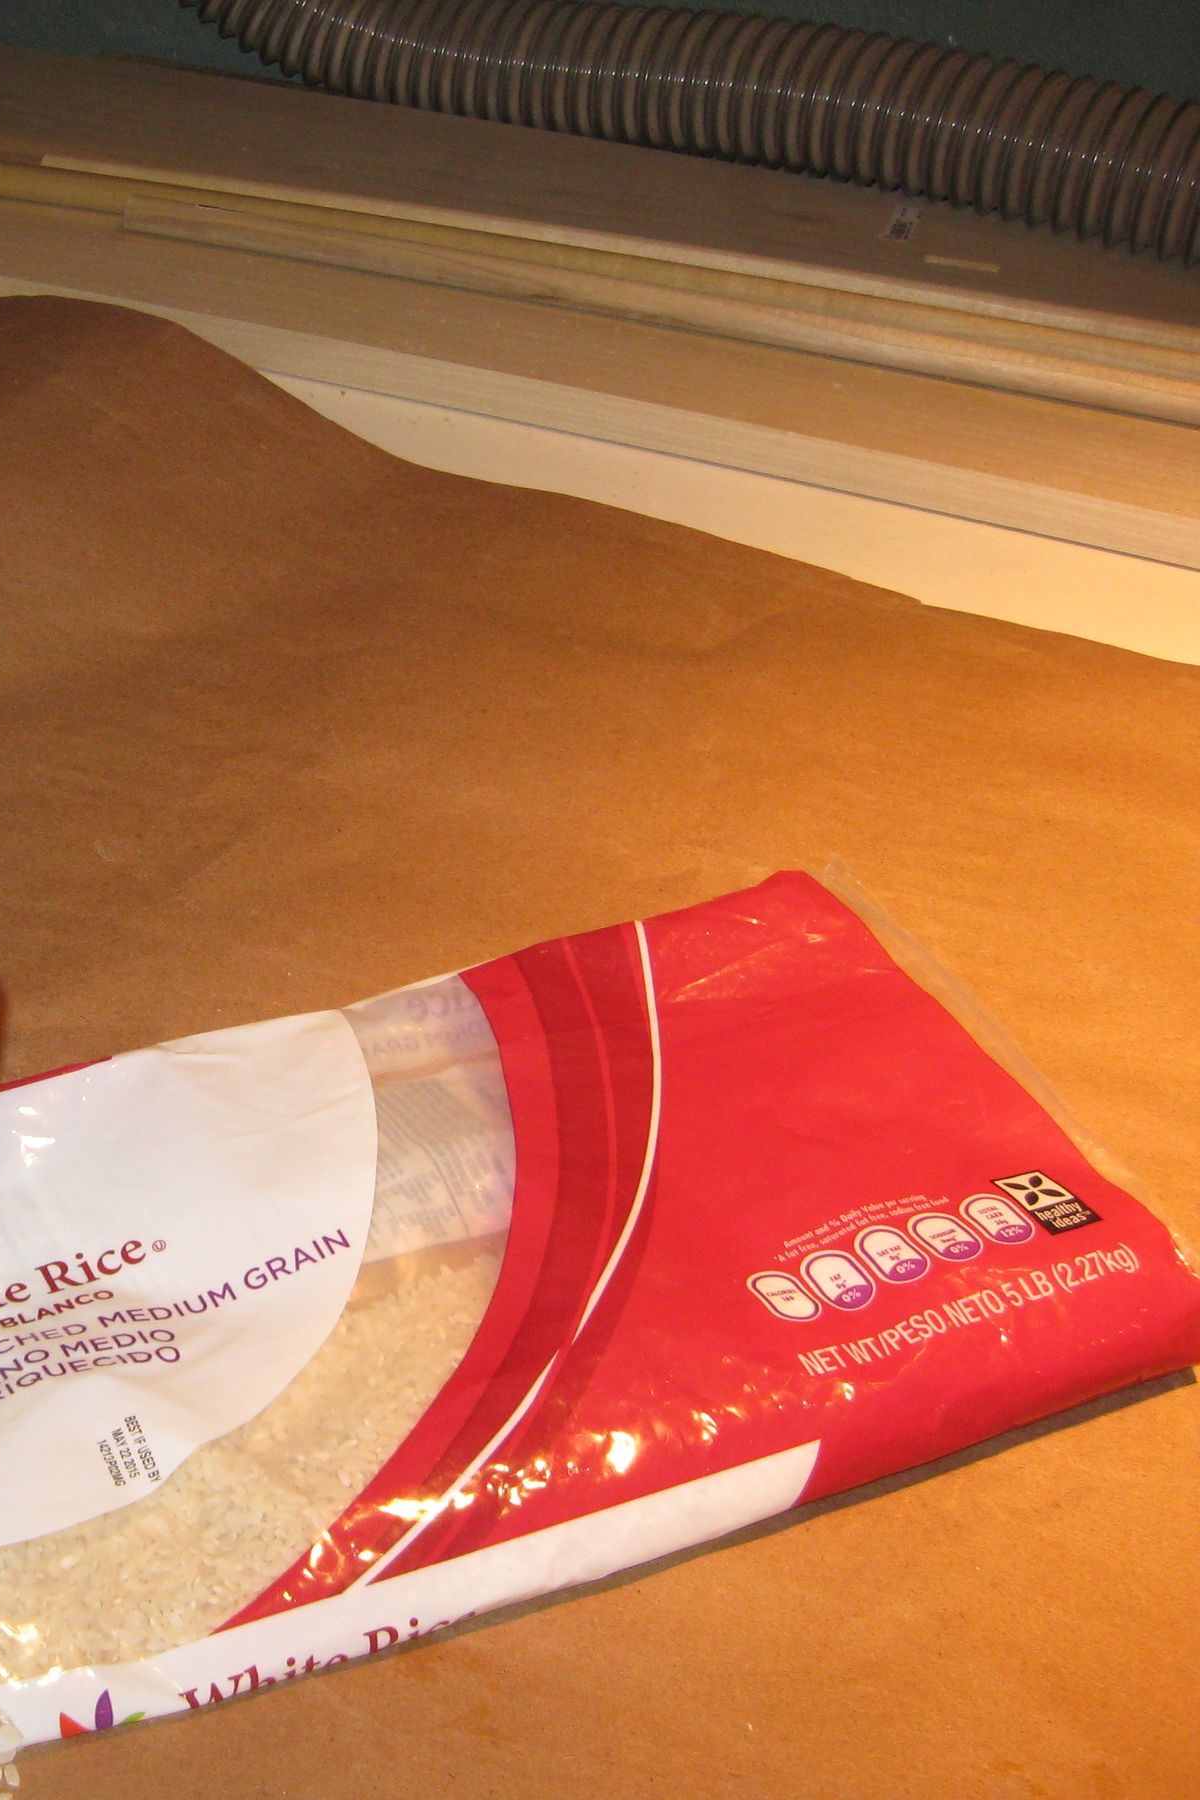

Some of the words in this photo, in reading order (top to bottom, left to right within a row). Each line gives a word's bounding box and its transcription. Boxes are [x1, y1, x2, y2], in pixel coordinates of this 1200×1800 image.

[1034, 1200, 1084, 1221] healthy
[783, 1231, 814, 1248] Amount
[815, 1223, 830, 1235] and
[839, 1208, 862, 1223] Daily
[860, 1202, 884, 1214] Value
[999, 1226, 1024, 1238] 12%
[950, 1243, 970, 1254] 0%
[34, 1239, 146, 1295] Rice
[895, 1259, 916, 1274] 0%
[97, 1282, 237, 1328] MEDIUM
[243, 1229, 351, 1290] GRAIN
[841, 1288, 862, 1303] 0%
[0, 1290, 114, 1329] BLANCO
[797, 1346, 848, 1377] NET
[846, 1308, 947, 1365] WT/PESO
[941, 1287, 1005, 1329] NETO
[1001, 1280, 1024, 1307] 5
[1017, 1269, 1055, 1302] LB
[1050, 1242, 1140, 1293] (2.27kg)
[59, 1329, 176, 1358] MEDIO
[124, 1415, 143, 1436] BEST
[111, 1427, 128, 1447] MAY
[133, 1435, 147, 1445] IF
[119, 1447, 132, 1459] 22
[137, 1445, 156, 1470] USED
[123, 1458, 141, 1479] 2015
[147, 1469, 162, 1483] BY
